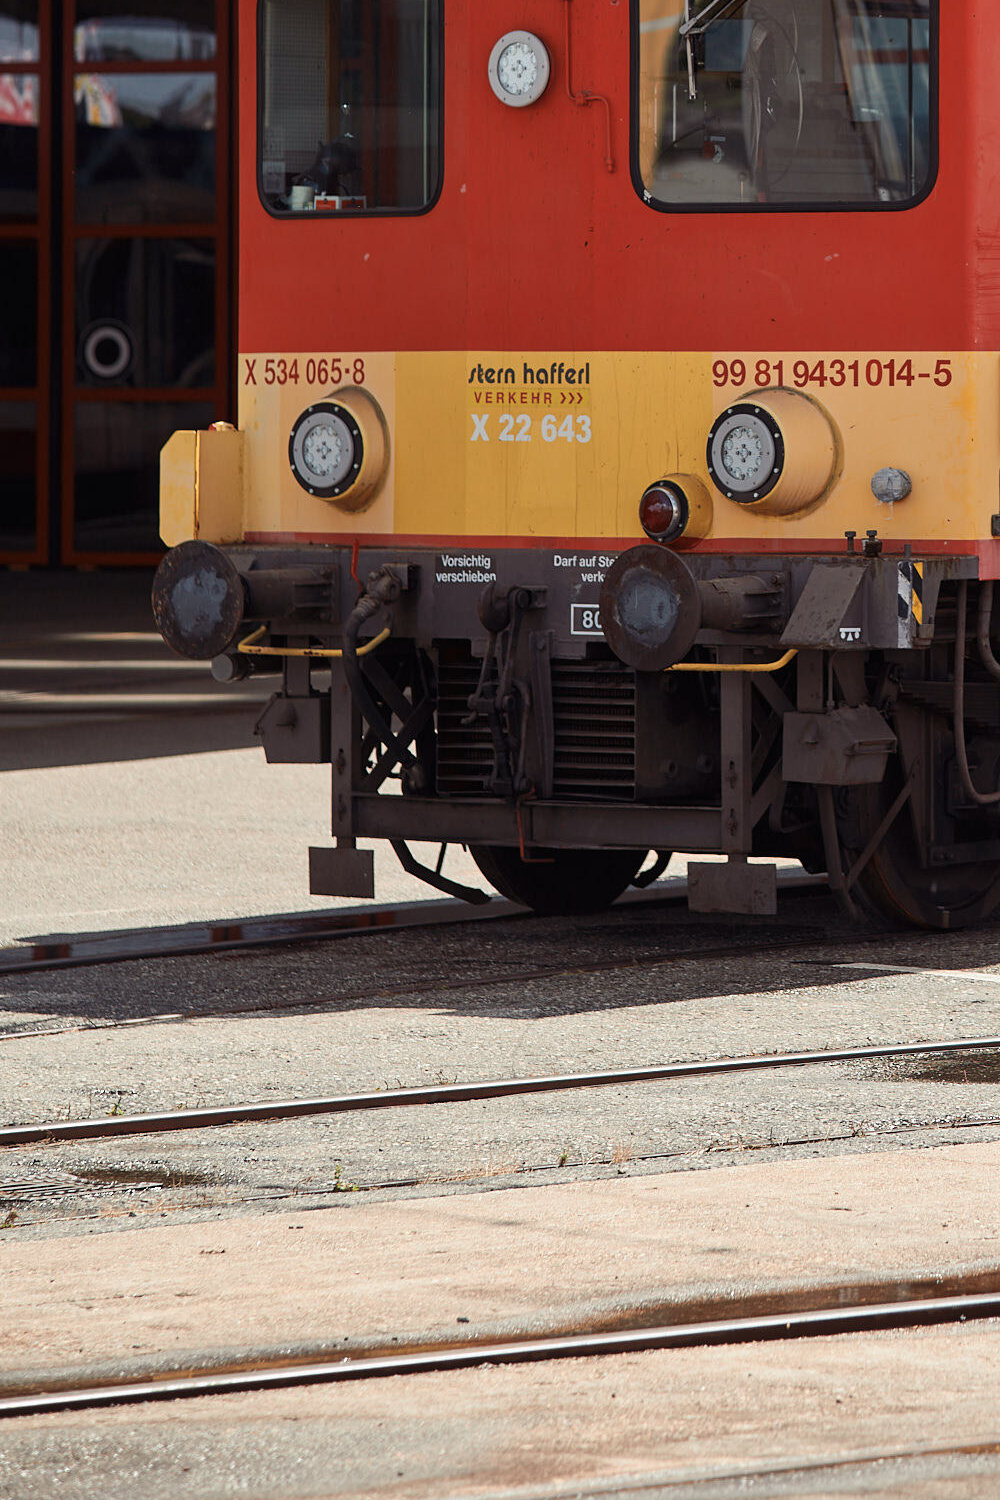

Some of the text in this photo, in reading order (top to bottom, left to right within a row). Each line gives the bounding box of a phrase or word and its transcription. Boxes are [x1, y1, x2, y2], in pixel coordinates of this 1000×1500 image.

[245, 359, 257, 385] X
[264, 359, 300, 385] 534
[468, 362, 590, 384] stern hafferl
[712, 359, 746, 387] 99
[754, 359, 784, 387] 81
[474, 391, 553, 404] VERKEHR
[470, 413, 592, 443] X 22 643
[441, 554, 491, 570] Vorsichtig
[553, 554, 618, 568] Darf auf Ste
[435, 570, 497, 583] verschieben
